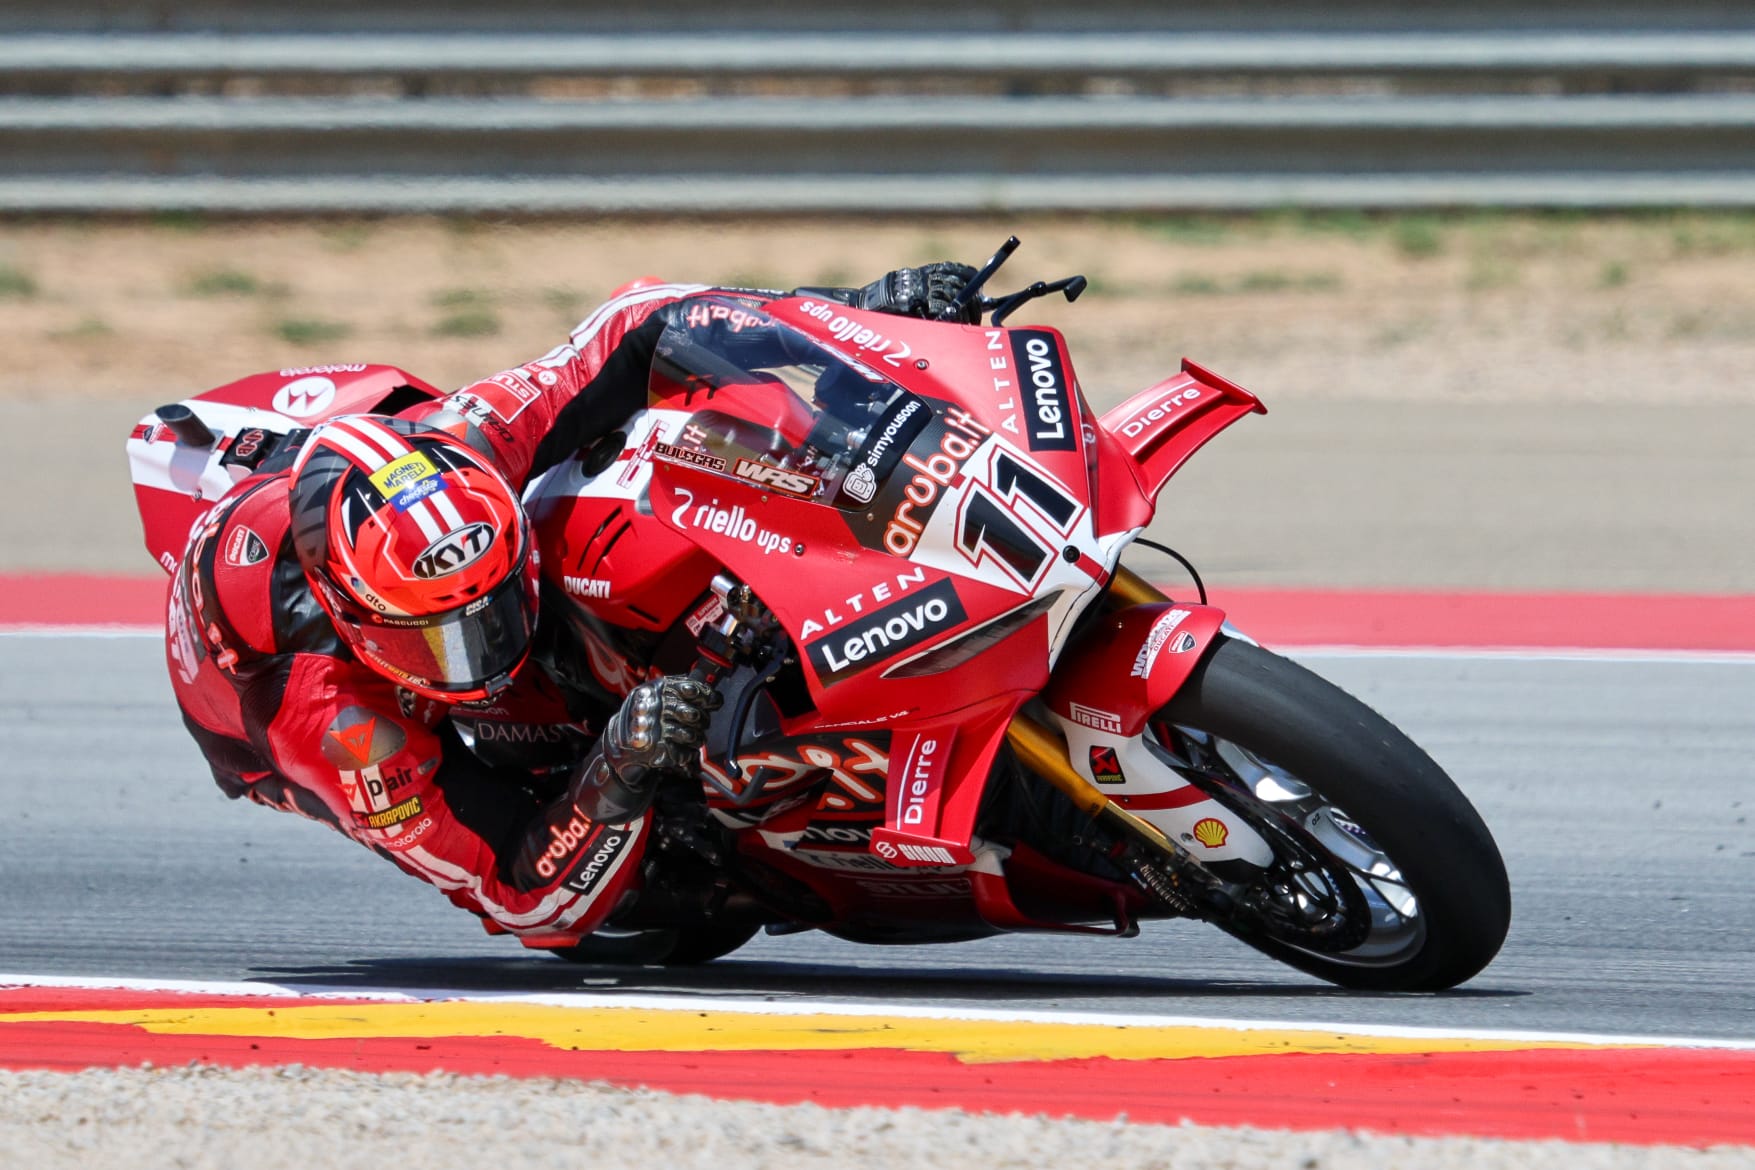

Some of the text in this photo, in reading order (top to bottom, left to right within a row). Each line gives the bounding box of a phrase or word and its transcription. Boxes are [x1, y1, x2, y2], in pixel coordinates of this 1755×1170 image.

[800, 301, 891, 352] riello ups
[985, 331, 1018, 434] ALTEN
[1026, 338, 1065, 440] Lenovo
[455, 395, 514, 442] DAINES
[867, 400, 921, 467] simyousoon
[1122, 388, 1201, 438] Dierre
[656, 442, 725, 471] BULEGAS
[736, 461, 814, 493] WRS
[883, 405, 995, 557] aruba.it
[229, 529, 245, 562] DUCATI
[693, 499, 791, 555] riello ups
[958, 449, 1084, 591] 11
[416, 523, 489, 578] KYT
[563, 576, 611, 600] DUCATI
[800, 567, 927, 639] ALTEN
[822, 597, 948, 673] Lenovo
[1069, 701, 1122, 734] PIRELLI
[904, 740, 937, 825] Dierre
[569, 836, 621, 889] Lenovo
